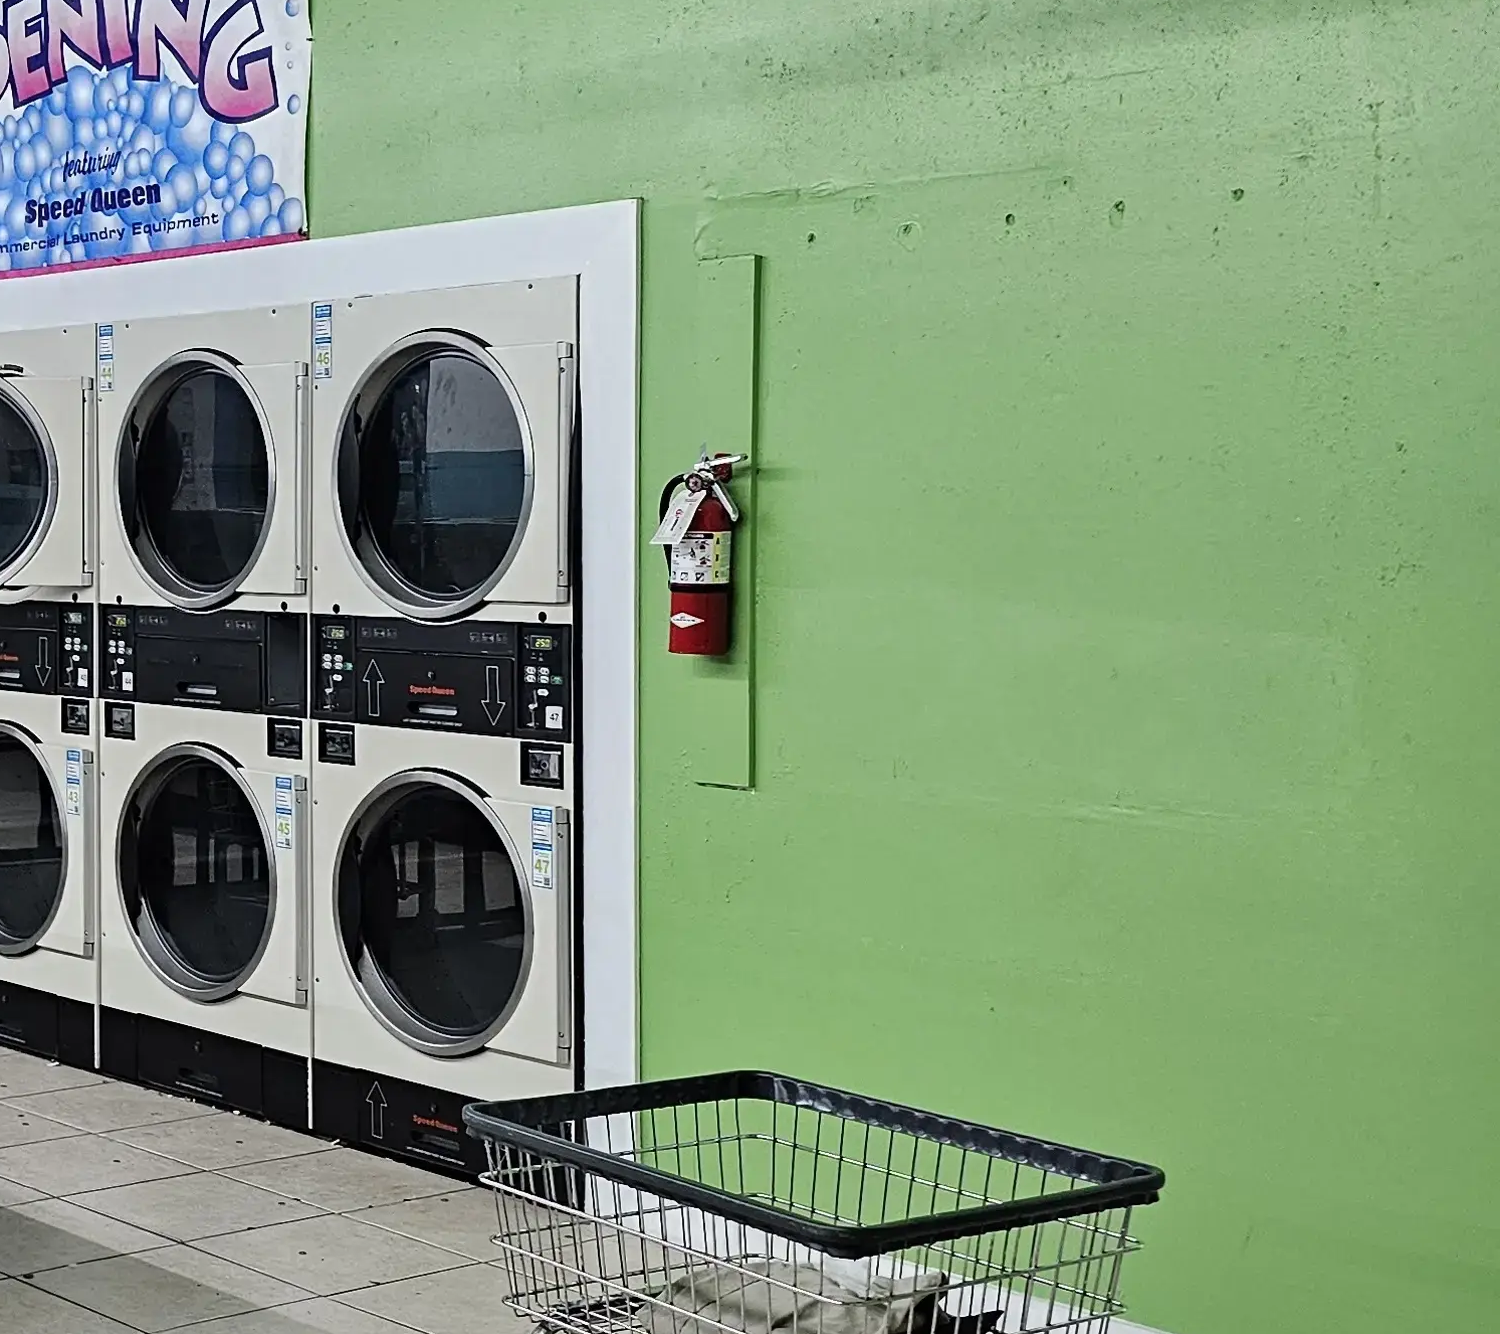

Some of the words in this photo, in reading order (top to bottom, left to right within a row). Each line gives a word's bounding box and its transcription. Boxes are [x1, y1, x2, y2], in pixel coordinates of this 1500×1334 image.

[62, 147, 122, 183] featuring
[24, 196, 85, 229] Speed
[89, 181, 162, 214] Queen
[63, 226, 126, 246] Laundry
[132, 212, 220, 237] Equipment
[316, 351, 330, 366] 46
[409, 684, 432, 696] Speed
[277, 821, 291, 836] 45
[534, 858, 550, 874] 47
